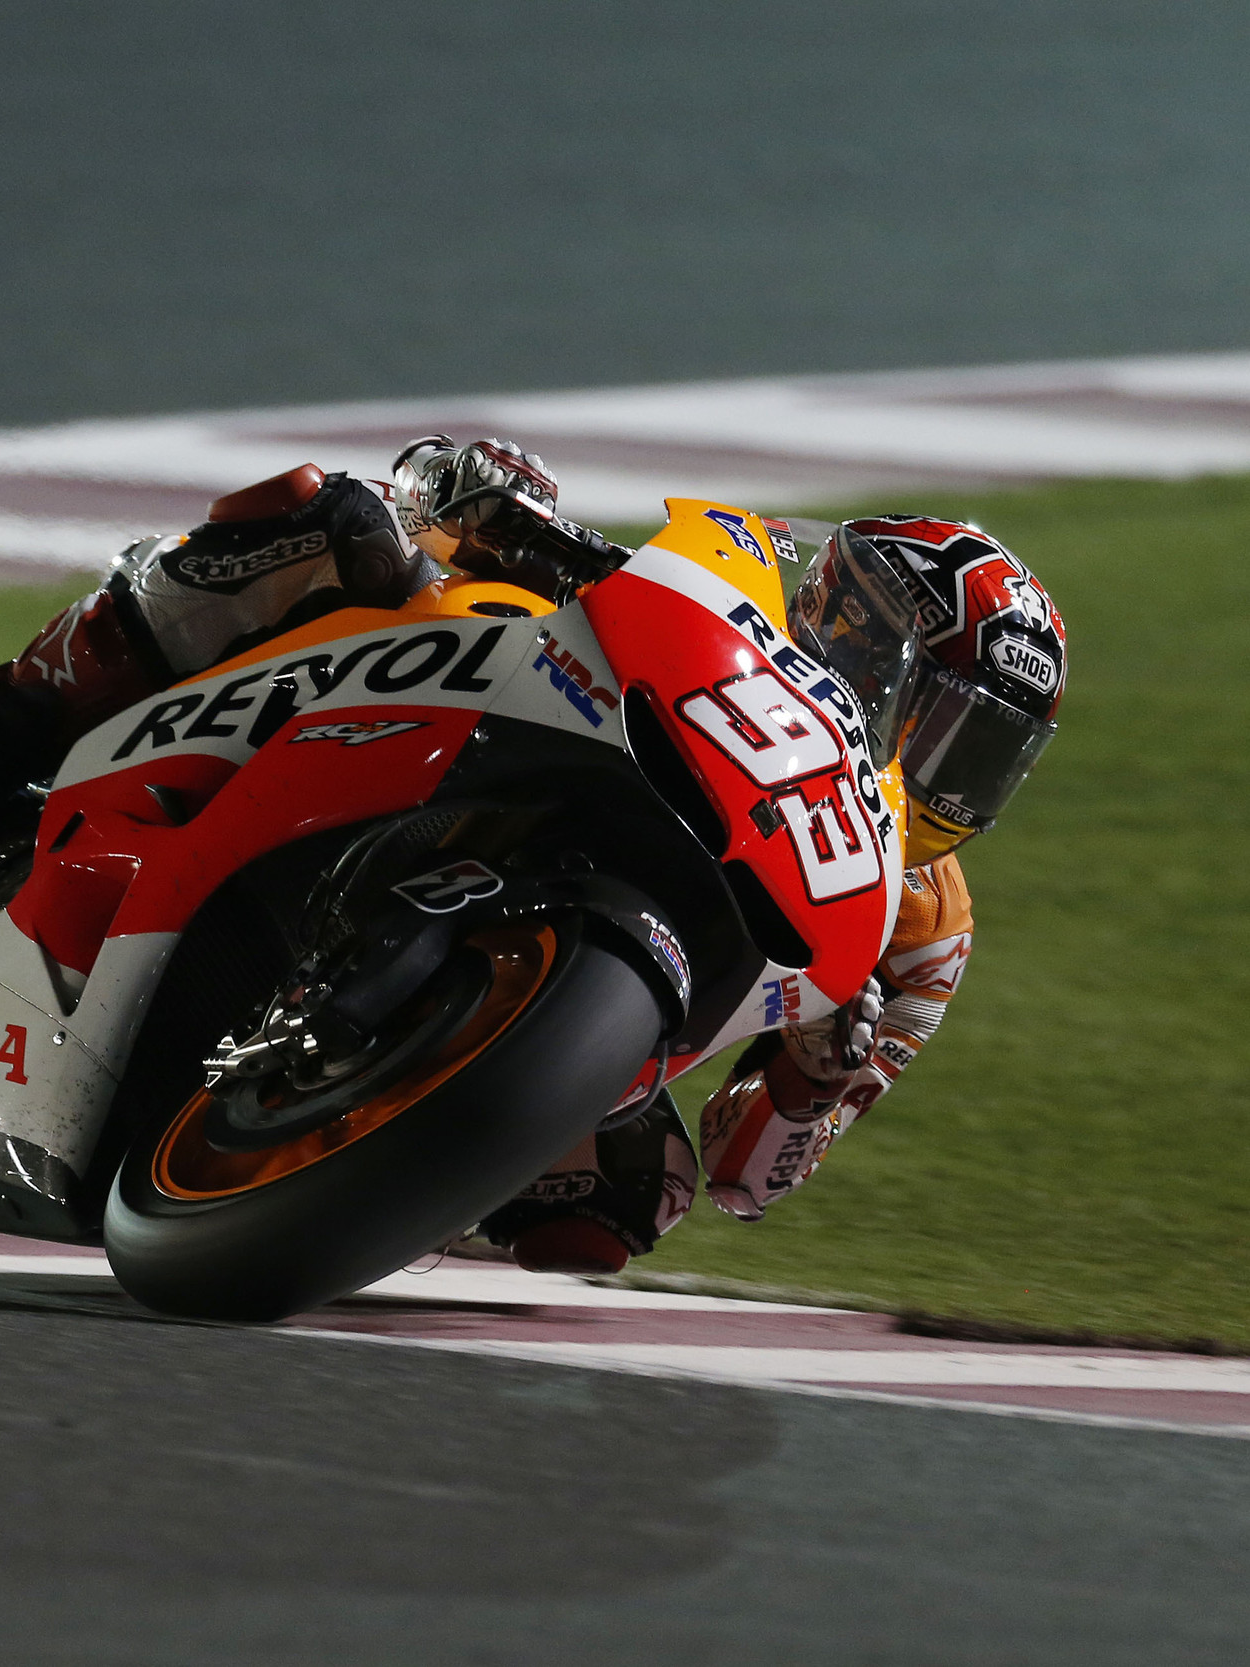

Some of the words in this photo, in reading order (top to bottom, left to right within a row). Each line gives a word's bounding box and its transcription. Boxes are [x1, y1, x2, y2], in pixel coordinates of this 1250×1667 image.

[110, 623, 508, 762] REPSOL
[532, 636, 620, 729] HRC
[1001, 644, 1051, 687] SHOEI
[673, 667, 882, 906] 93
[929, 796, 974, 826] LOTUS
